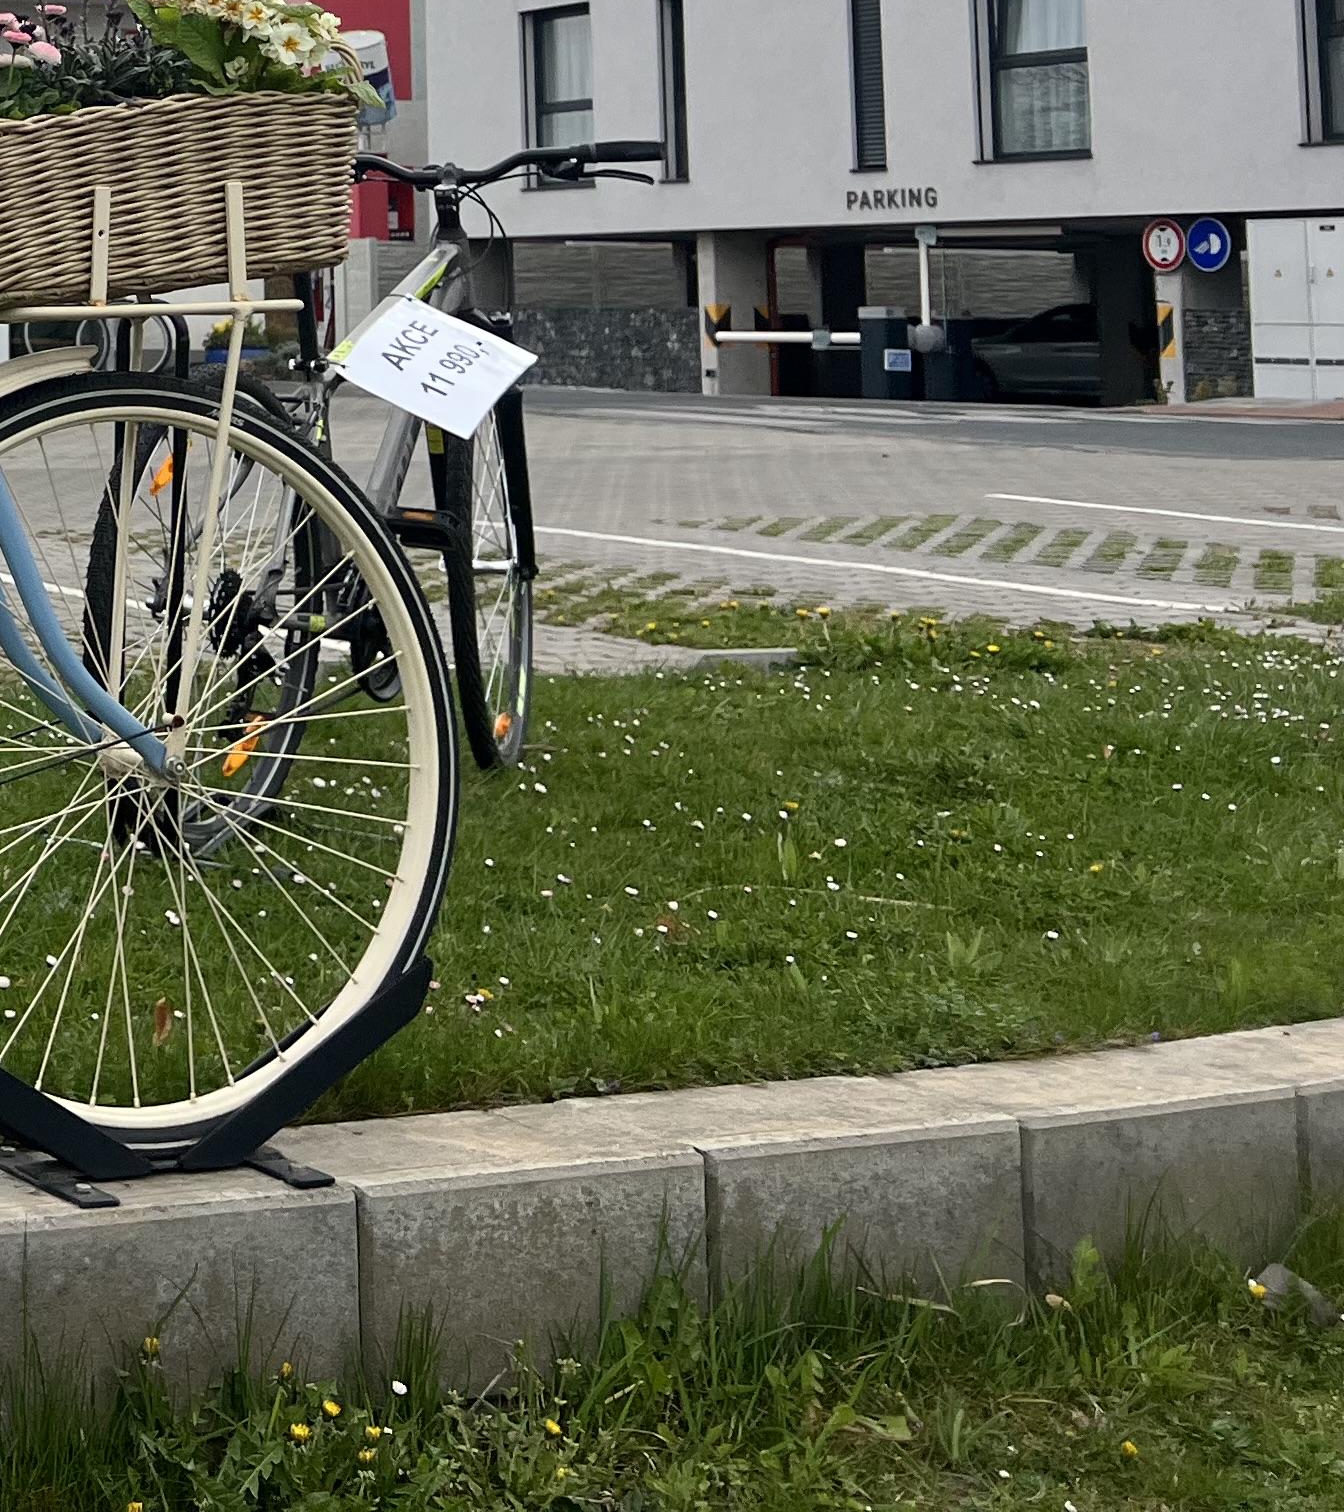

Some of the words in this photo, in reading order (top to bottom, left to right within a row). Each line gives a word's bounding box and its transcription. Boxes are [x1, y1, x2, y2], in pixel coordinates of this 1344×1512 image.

[846, 187, 938, 210] PARKING
[380, 320, 439, 371] AKCE
[420, 372, 456, 397] 11
